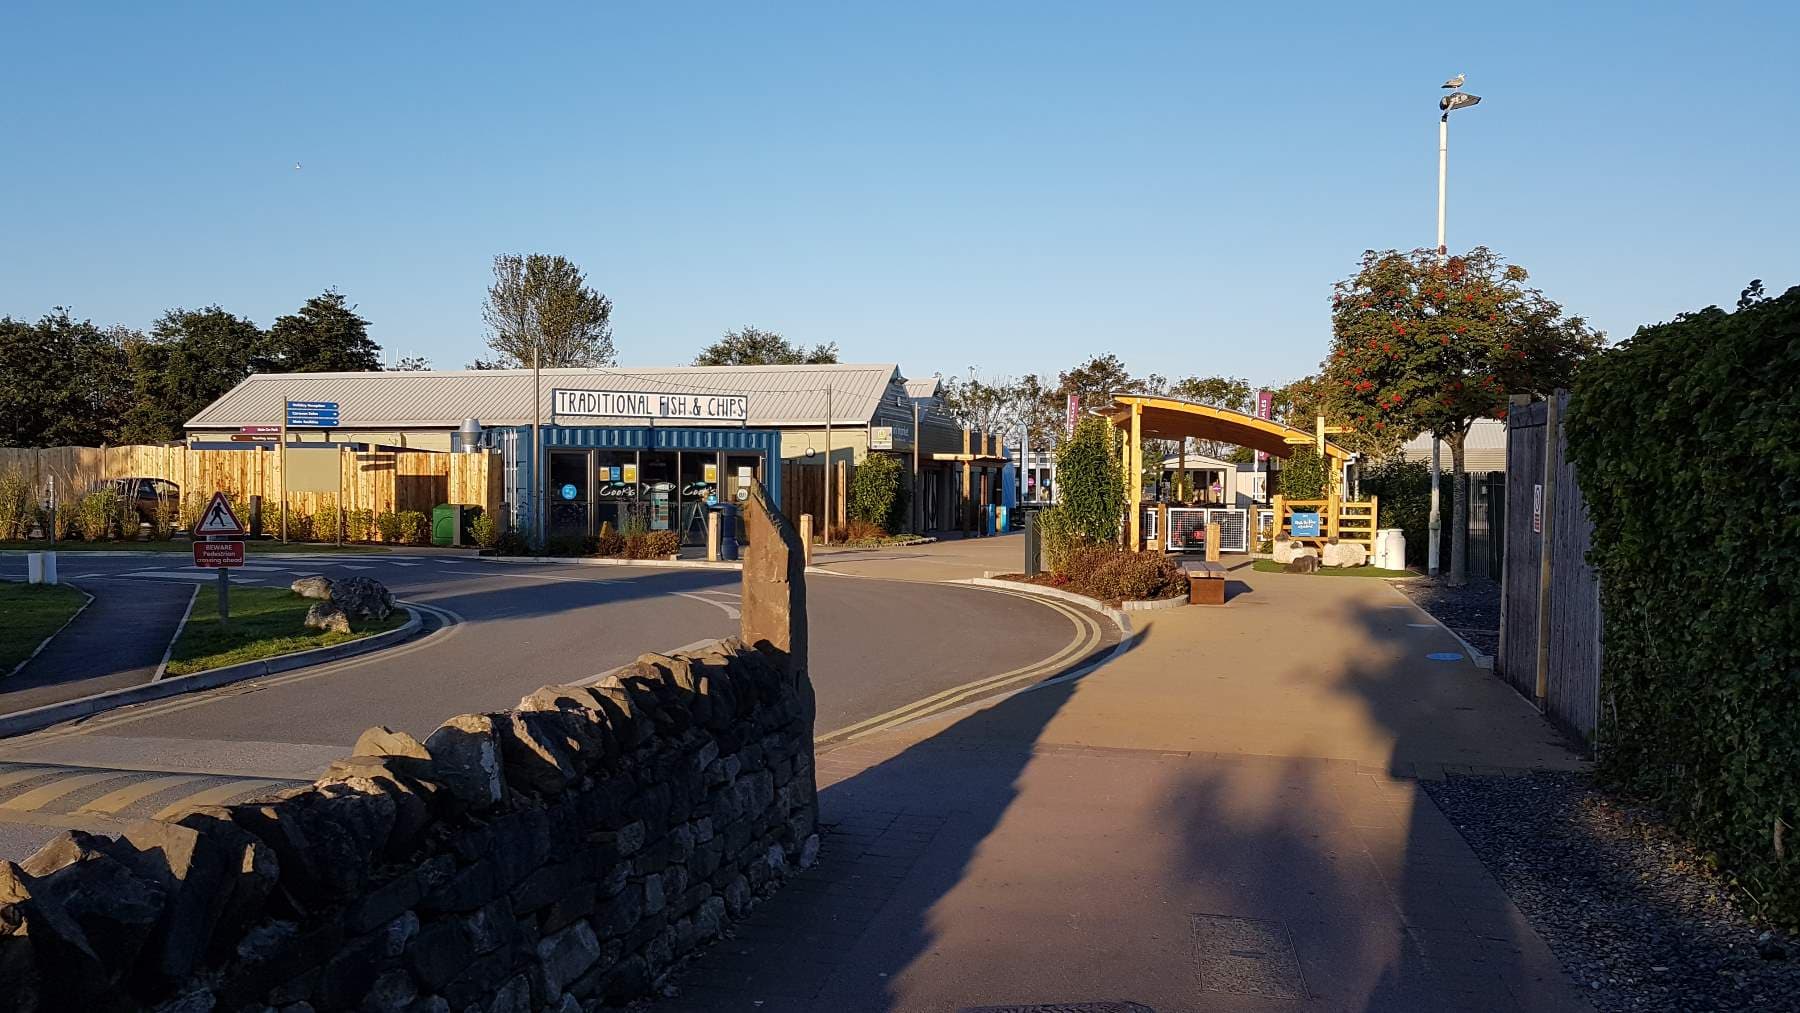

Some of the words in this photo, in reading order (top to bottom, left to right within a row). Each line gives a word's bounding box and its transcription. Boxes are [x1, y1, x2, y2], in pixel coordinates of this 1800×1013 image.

[559, 392, 652, 414] TRADITIONAL
[660, 396, 686, 415] FISH
[693, 397, 701, 416] &
[708, 397, 744, 417] CHIPS
